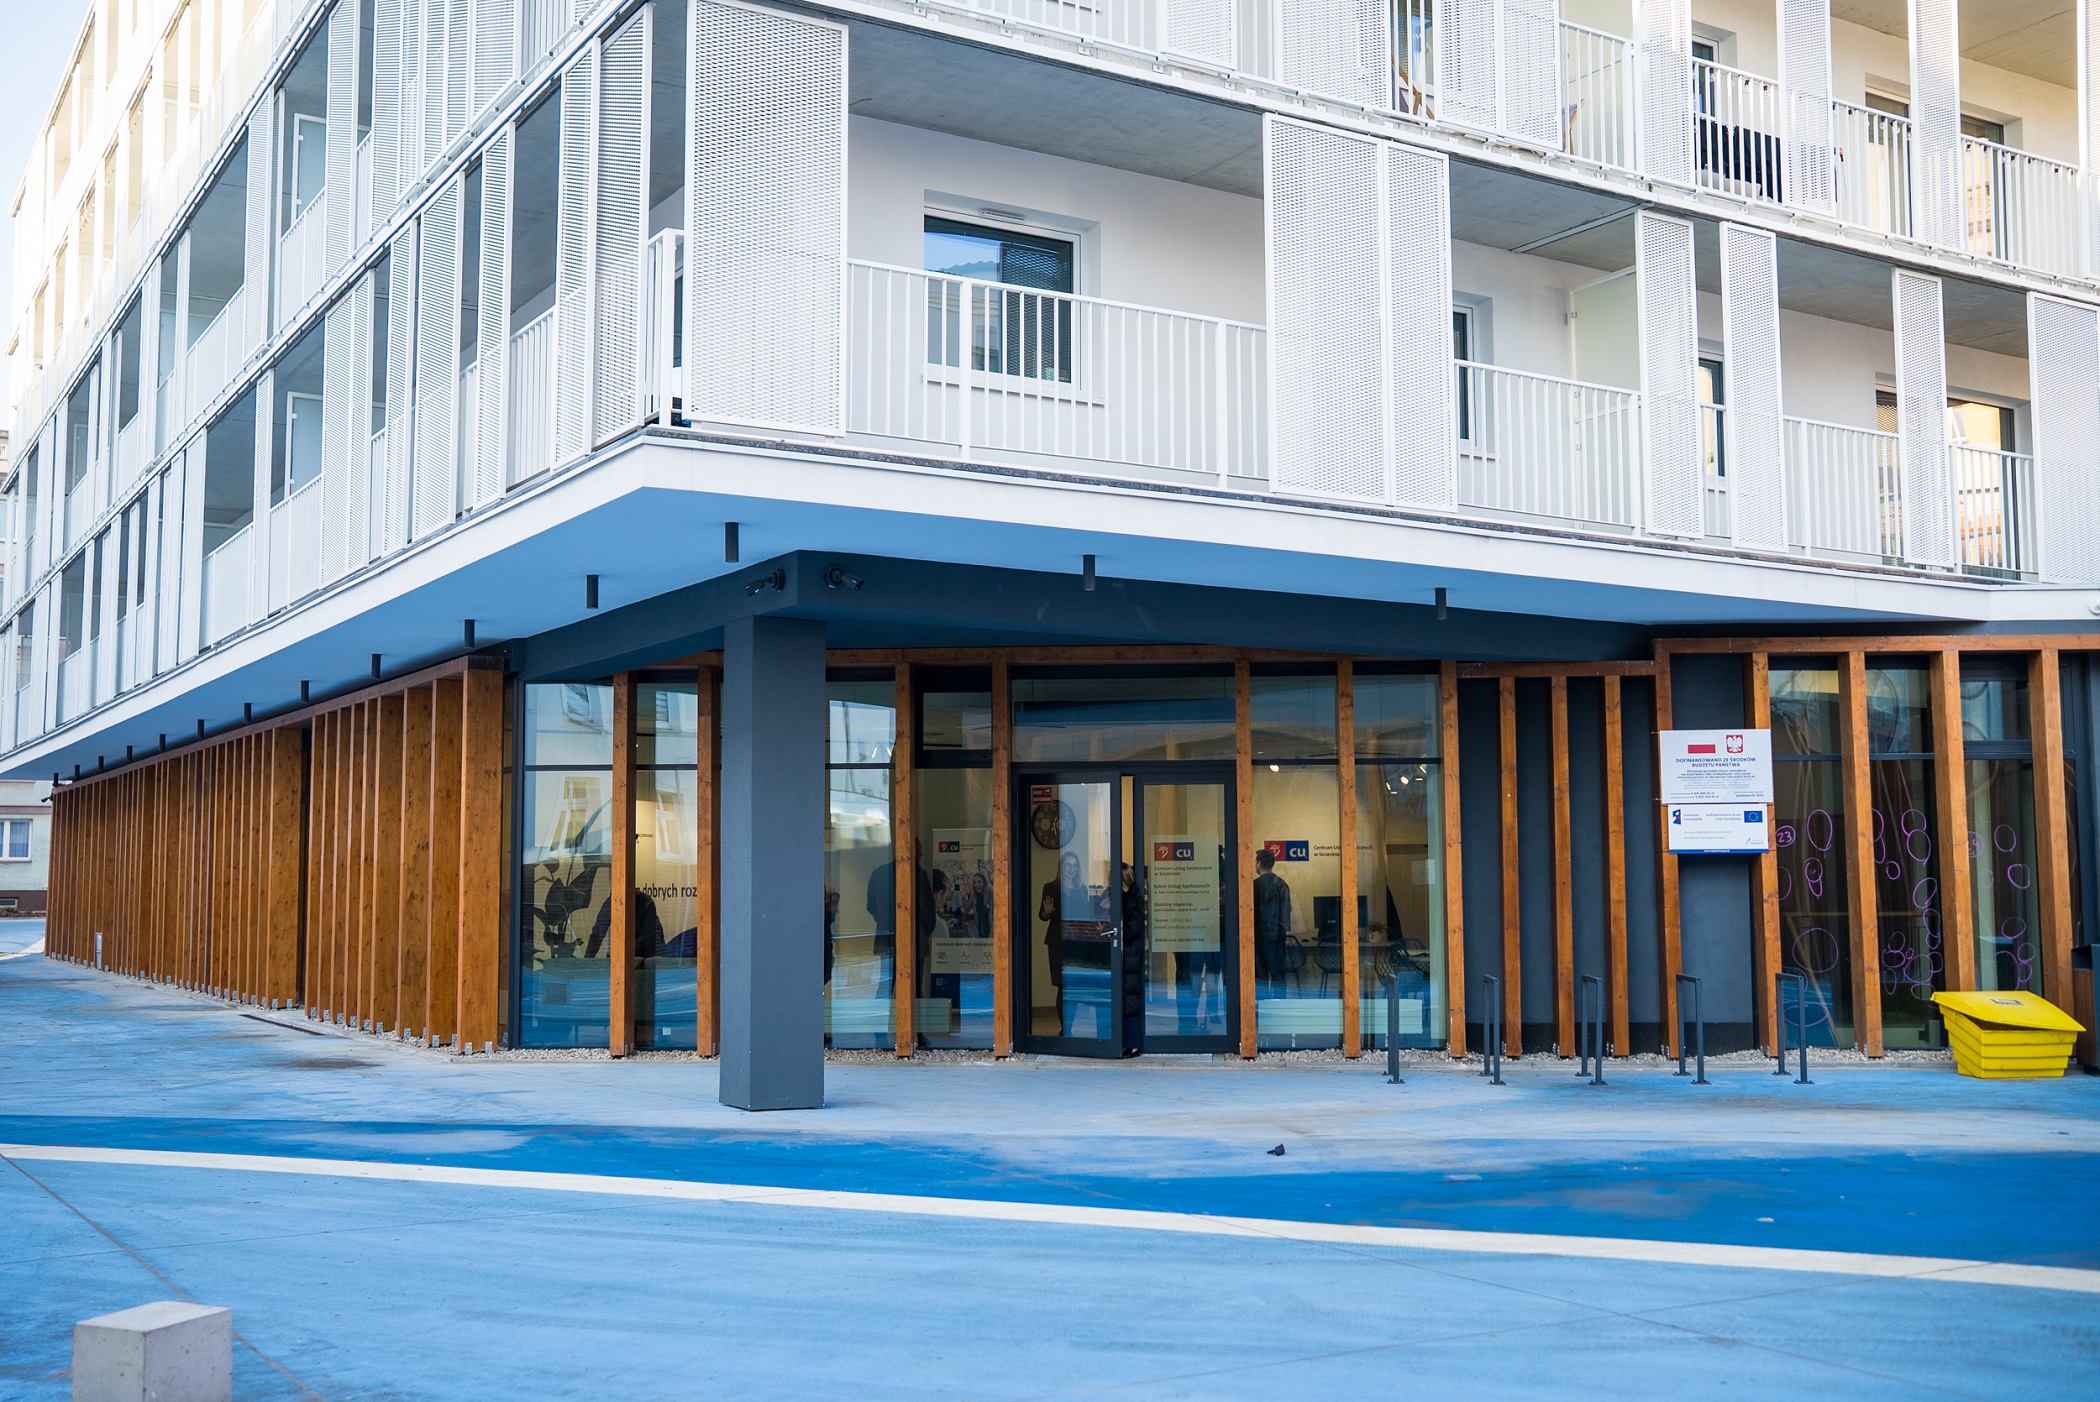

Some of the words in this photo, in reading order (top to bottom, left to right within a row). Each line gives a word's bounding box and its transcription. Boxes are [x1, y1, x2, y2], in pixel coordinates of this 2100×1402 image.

[1777, 831, 1792, 843] 23
[642, 883, 677, 901] dobrych
[681, 887, 698, 897] roz
